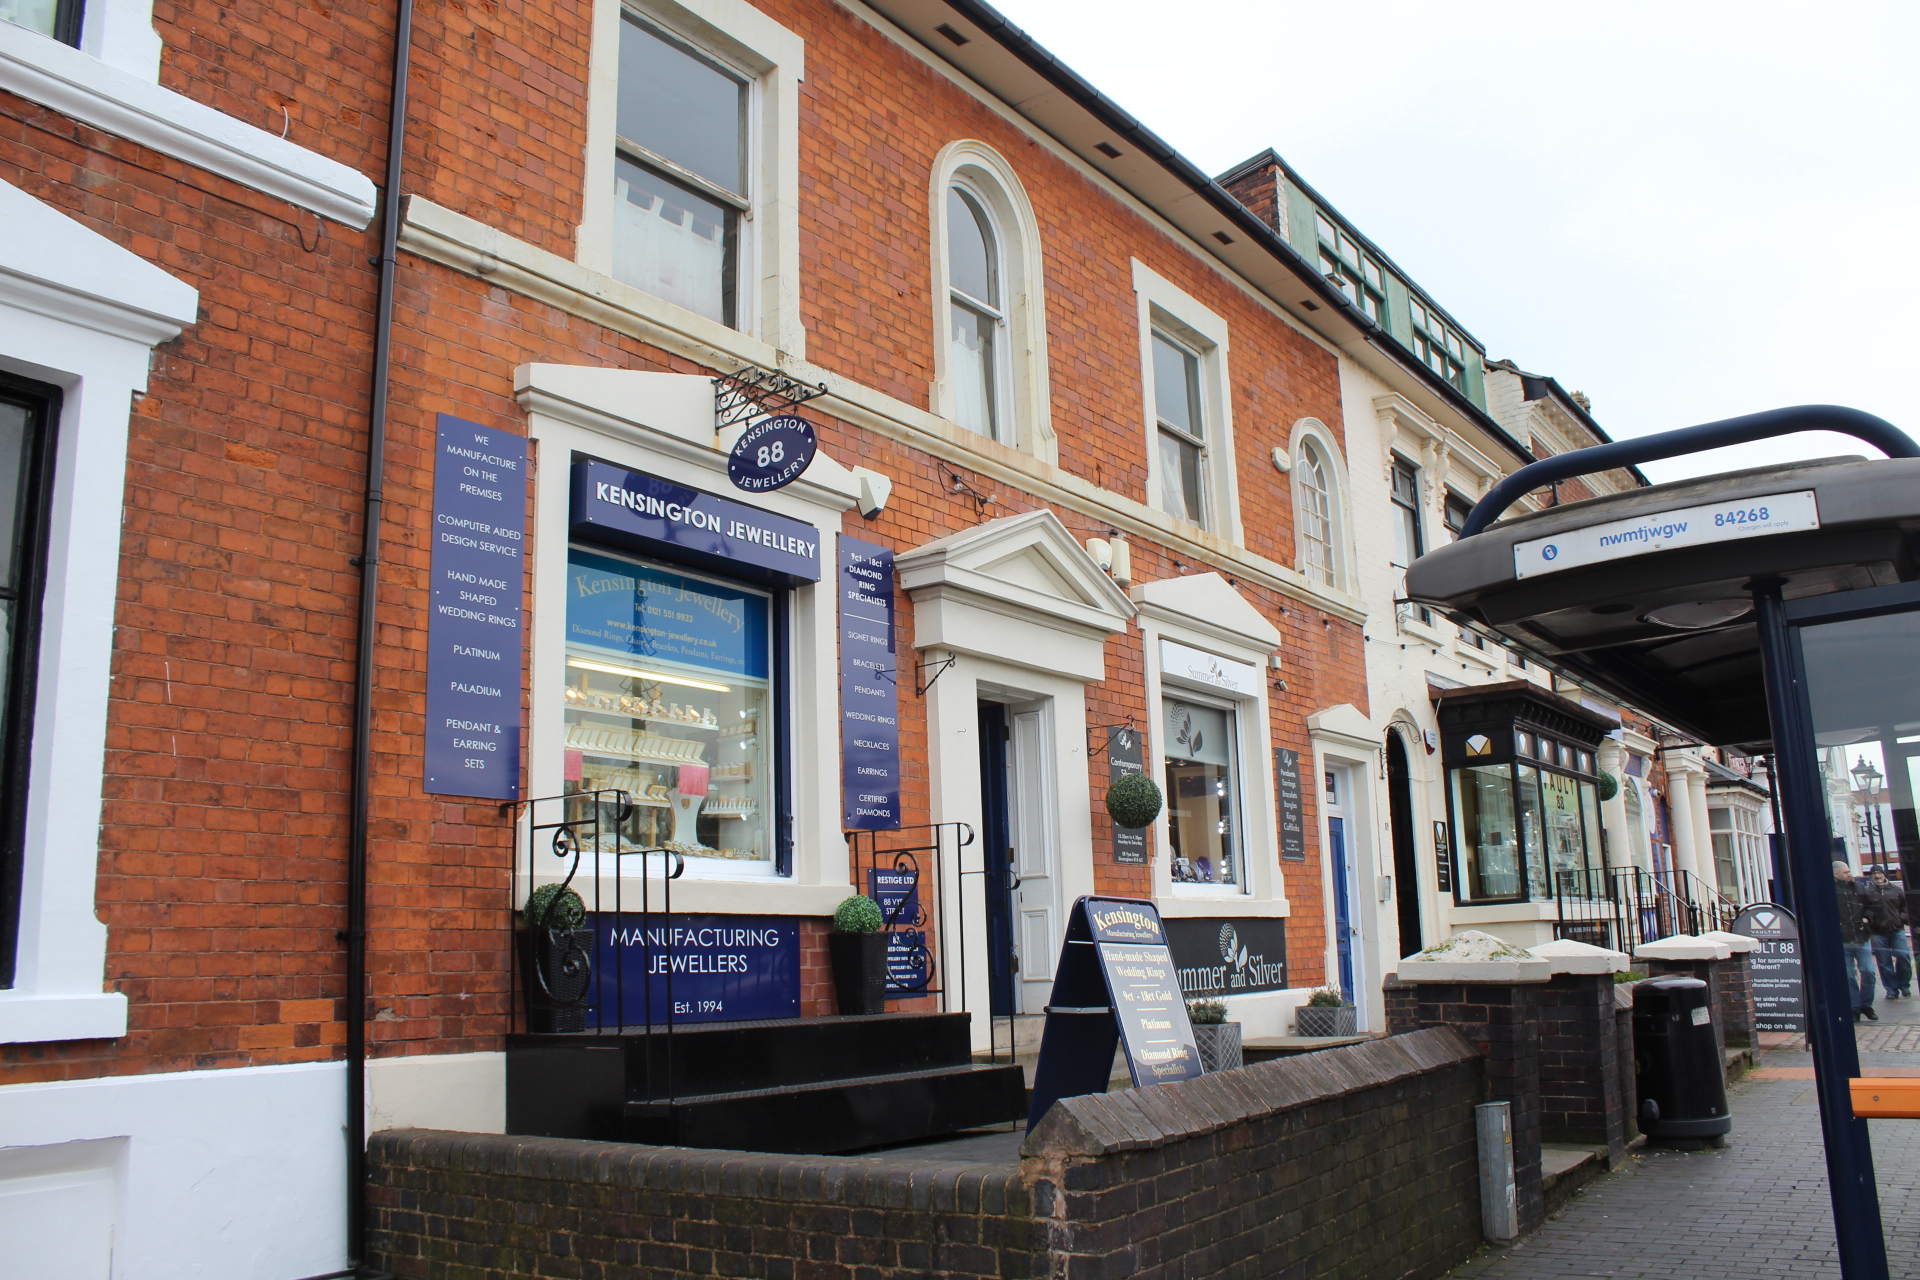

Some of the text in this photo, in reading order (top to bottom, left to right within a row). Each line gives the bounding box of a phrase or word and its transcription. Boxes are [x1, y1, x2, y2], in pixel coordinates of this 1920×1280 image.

[474, 434, 489, 446] WE
[735, 419, 806, 456] KENSINGTON
[447, 445, 516, 470] MANUFACTURE
[757, 441, 784, 468] 88
[463, 467, 497, 482] ON THE
[739, 453, 805, 488] JEWELLERY
[460, 483, 502, 501] PREMISES
[437, 514, 521, 540] COMPUTER AIDED
[597, 482, 816, 558] KENSINGTON JEWELLERY
[1599, 507, 1770, 547] nwmtjwgw 84268
[1738, 524, 1761, 532] Charges
[1773, 520, 1789, 528] apply
[441, 533, 517, 557] DESIGN SERVICE
[851, 553, 862, 562] 9ct
[868, 557, 882, 568] 18ct
[448, 570, 507, 590] HAND MADE
[849, 565, 882, 580] DIAMOND
[859, 581, 875, 591] RING
[460, 591, 497, 606] SHAPED
[575, 571, 744, 633] Kensington Jewellery
[848, 591, 886, 607] SPECIALISTS
[438, 605, 516, 628] WEDDING RINGS
[648, 606, 661, 616] 0121
[663, 610, 674, 618] 551
[677, 613, 693, 622] 9933
[572, 624, 601, 637] Diamond
[607, 620, 717, 647] www.kensington-jewellery.co.uk
[848, 631, 888, 646] SIGNET RINGS
[454, 645, 500, 661] PLATINUM
[853, 659, 885, 671] BRACELETS
[1188, 665, 1214, 683] Summer
[1222, 675, 1238, 689] Silver
[451, 682, 501, 697] PALADIUM
[855, 686, 885, 697] PENDANTS
[846, 711, 895, 725] WEDDING RINGS
[446, 719, 501, 734] PENDANT &
[453, 738, 497, 752] EARRING
[854, 740, 889, 750] NECKLACES
[465, 759, 484, 769] SETS
[858, 767, 887, 776] EARRINGS
[859, 794, 887, 803] CERTIFIED
[1557, 795, 1564, 810] 88
[857, 808, 890, 817] DIAMONDS
[1093, 906, 1160, 934] Kensington
[610, 928, 779, 947] MANUFACTURING
[1780, 942, 1794, 954] 88
[648, 955, 747, 974] JEWELLERS
[1105, 950, 1168, 964] Hand-made Shaped
[1116, 966, 1165, 979] Wedding Rings
[1178, 955, 1282, 991] mmer and Silver
[1123, 991, 1133, 1001] 9ct
[1141, 991, 1154, 1001] 18ct
[1156, 990, 1172, 1001] Gold
[675, 1001, 723, 1013] Est. 1994
[1141, 1019, 1171, 1029] Platinum
[1141, 1049, 1188, 1060] Diamond Ring
[1152, 1064, 1186, 1078] Specialists
